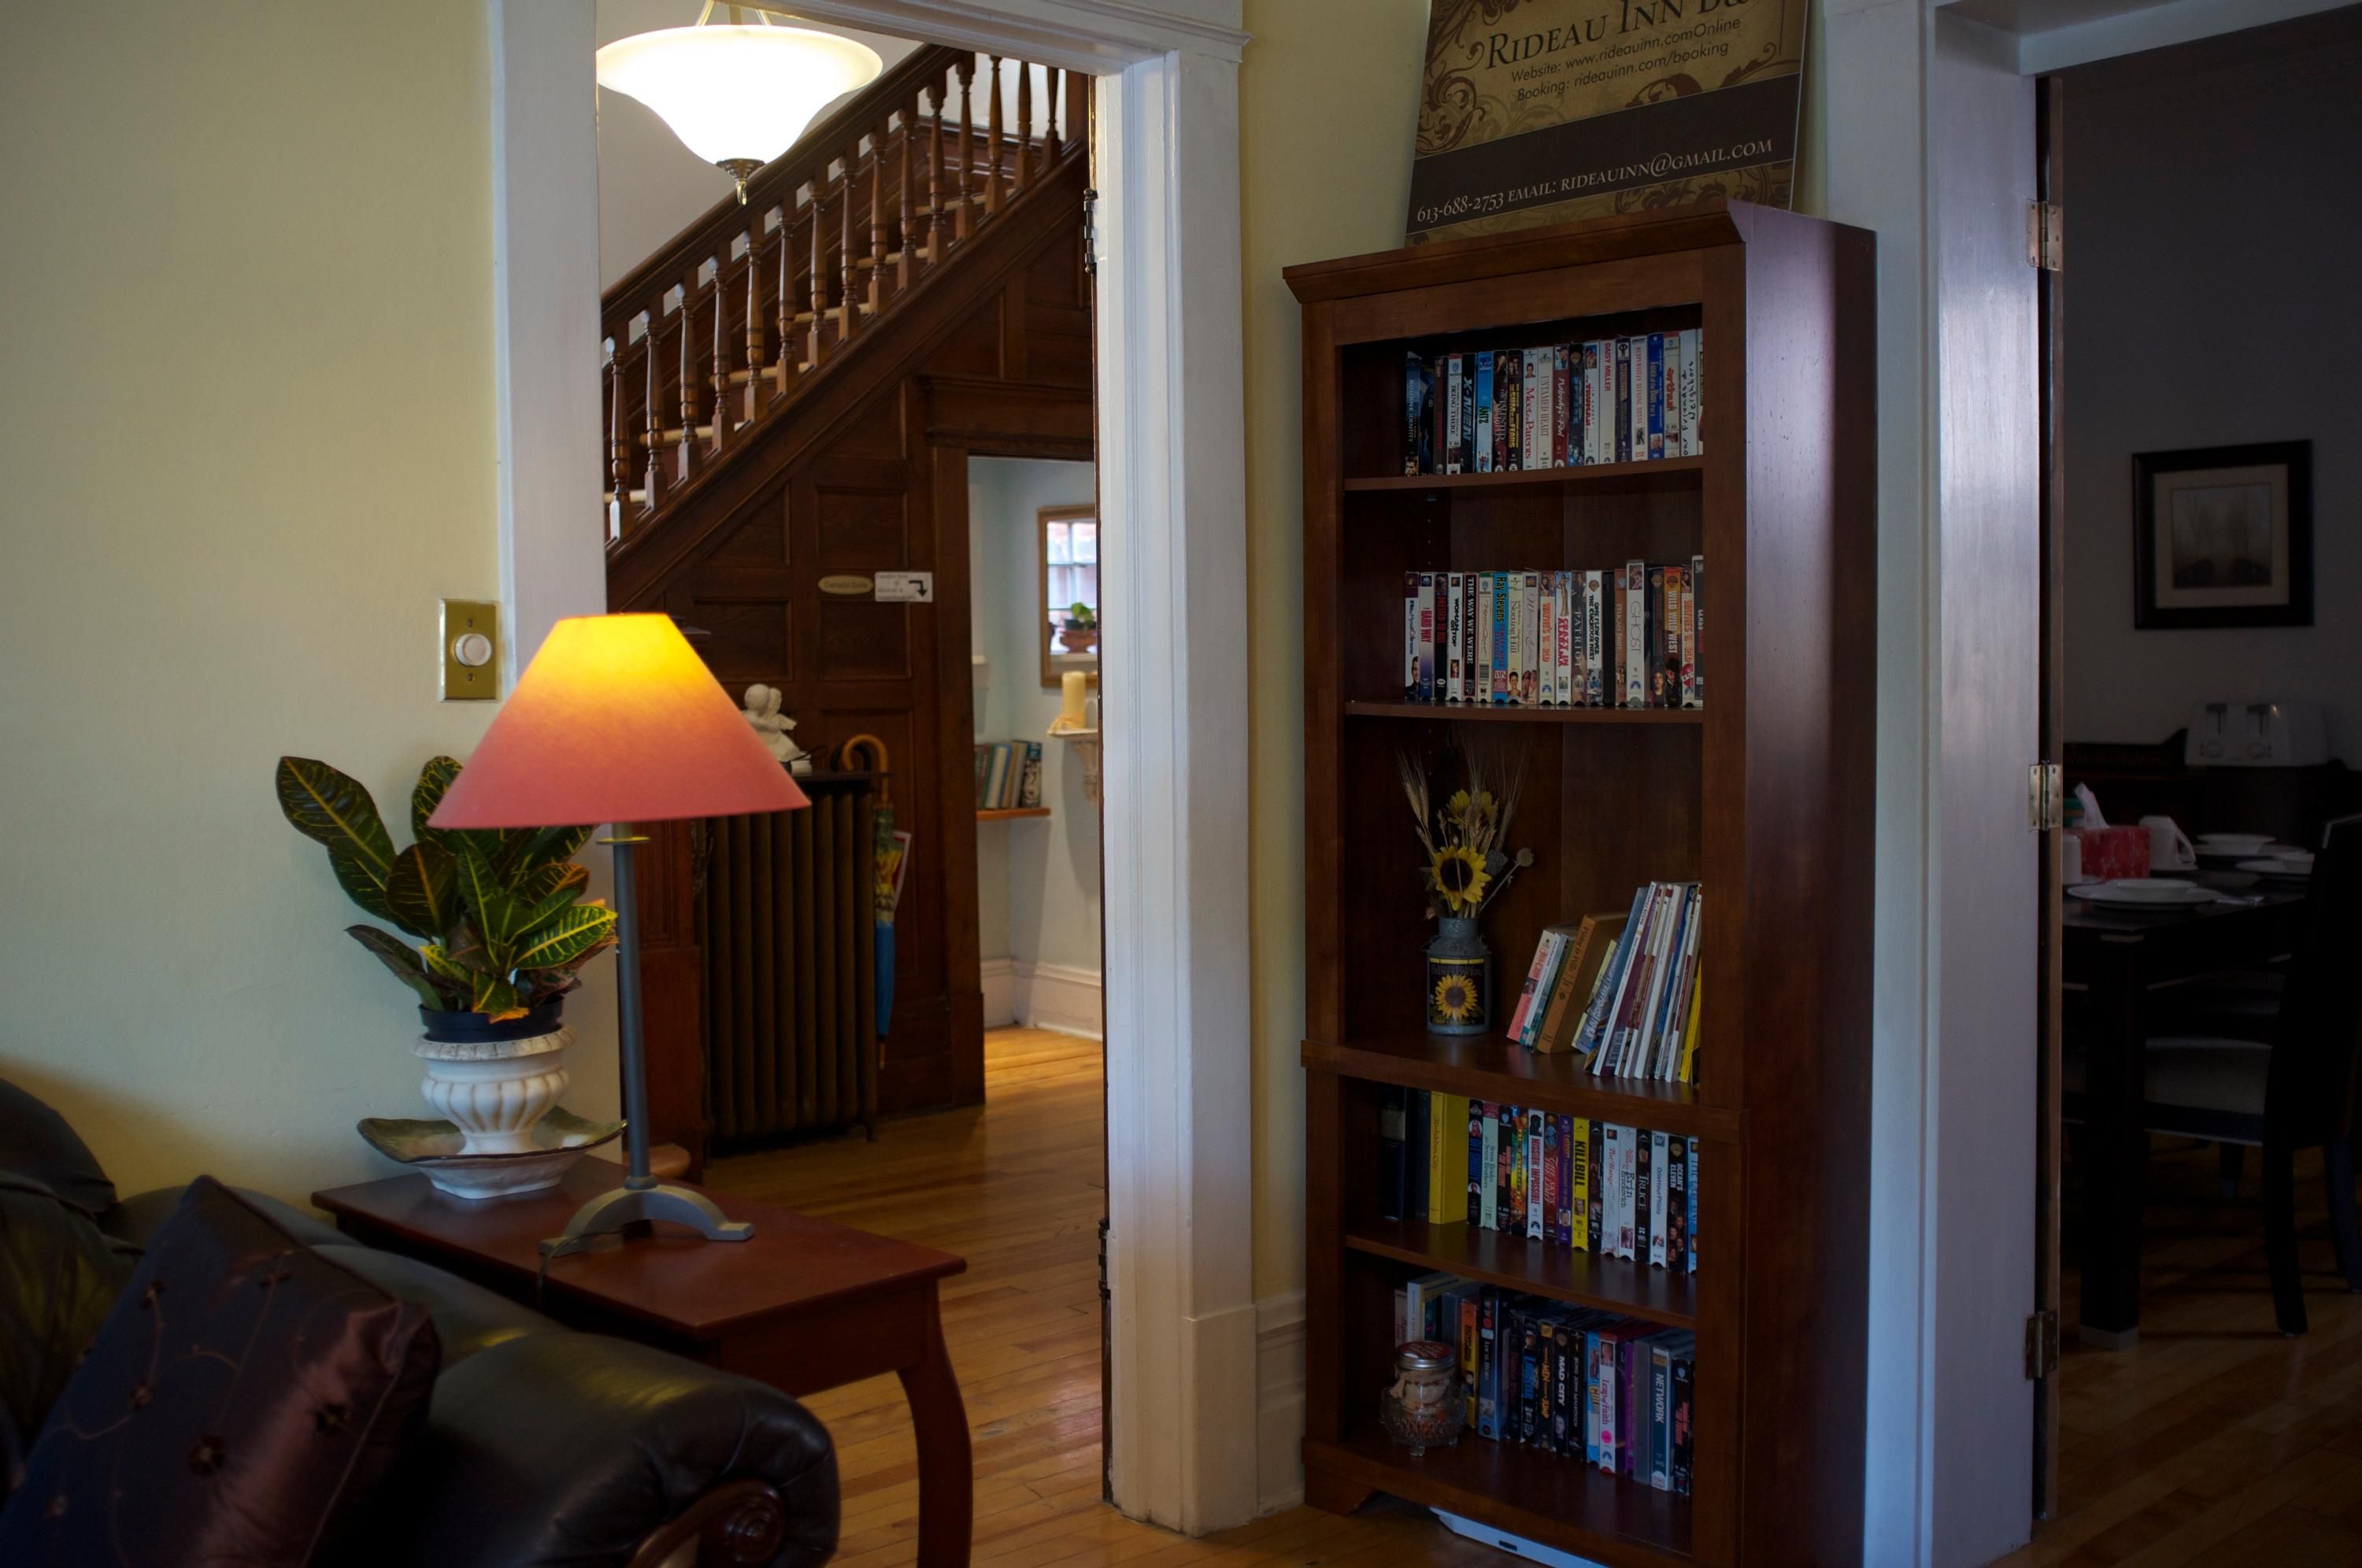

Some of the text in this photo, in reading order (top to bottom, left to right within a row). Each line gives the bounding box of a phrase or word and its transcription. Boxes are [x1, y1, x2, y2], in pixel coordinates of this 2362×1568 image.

[1486, 15, 1609, 69] RIDEAU
[1511, 19, 1741, 83] Website: www.rideauinn.comOnline
[1517, 43, 1729, 101] Booking: rideauinn.com/booking
[1417, 139, 1772, 223] 613-688-2753 EMAIL: RIDEAUINN@GMAIL.COM
[1463, 376, 1473, 441] X-MEN
[1479, 405, 1489, 424] ANTZ
[1525, 387, 1535, 413] Meet
[1540, 375, 1550, 438] UNTAMED HEART
[1525, 421, 1535, 460] Parents
[1495, 577, 1507, 623] Ray Stevens
[1509, 601, 1518, 635] Notting
[1668, 590, 1678, 654] WILD WILD WEST
[1420, 610, 1432, 643] HARD WAY
[1450, 620, 1456, 631] on
[1467, 619, 1475, 635] WE
[1574, 611, 1583, 668] PATRIOT
[1631, 601, 1642, 654] GHOST
[1431, 1114, 1441, 1172] Forbidden City
[1531, 1138, 1541, 1204] MISSION: IMPOSSIBLE
[1627, 1171, 1635, 1198] Erin
[1638, 1172, 1649, 1211] TRUCE
[1601, 1379, 1609, 1398] Leap
[1655, 1373, 1664, 1423] NETWORK
